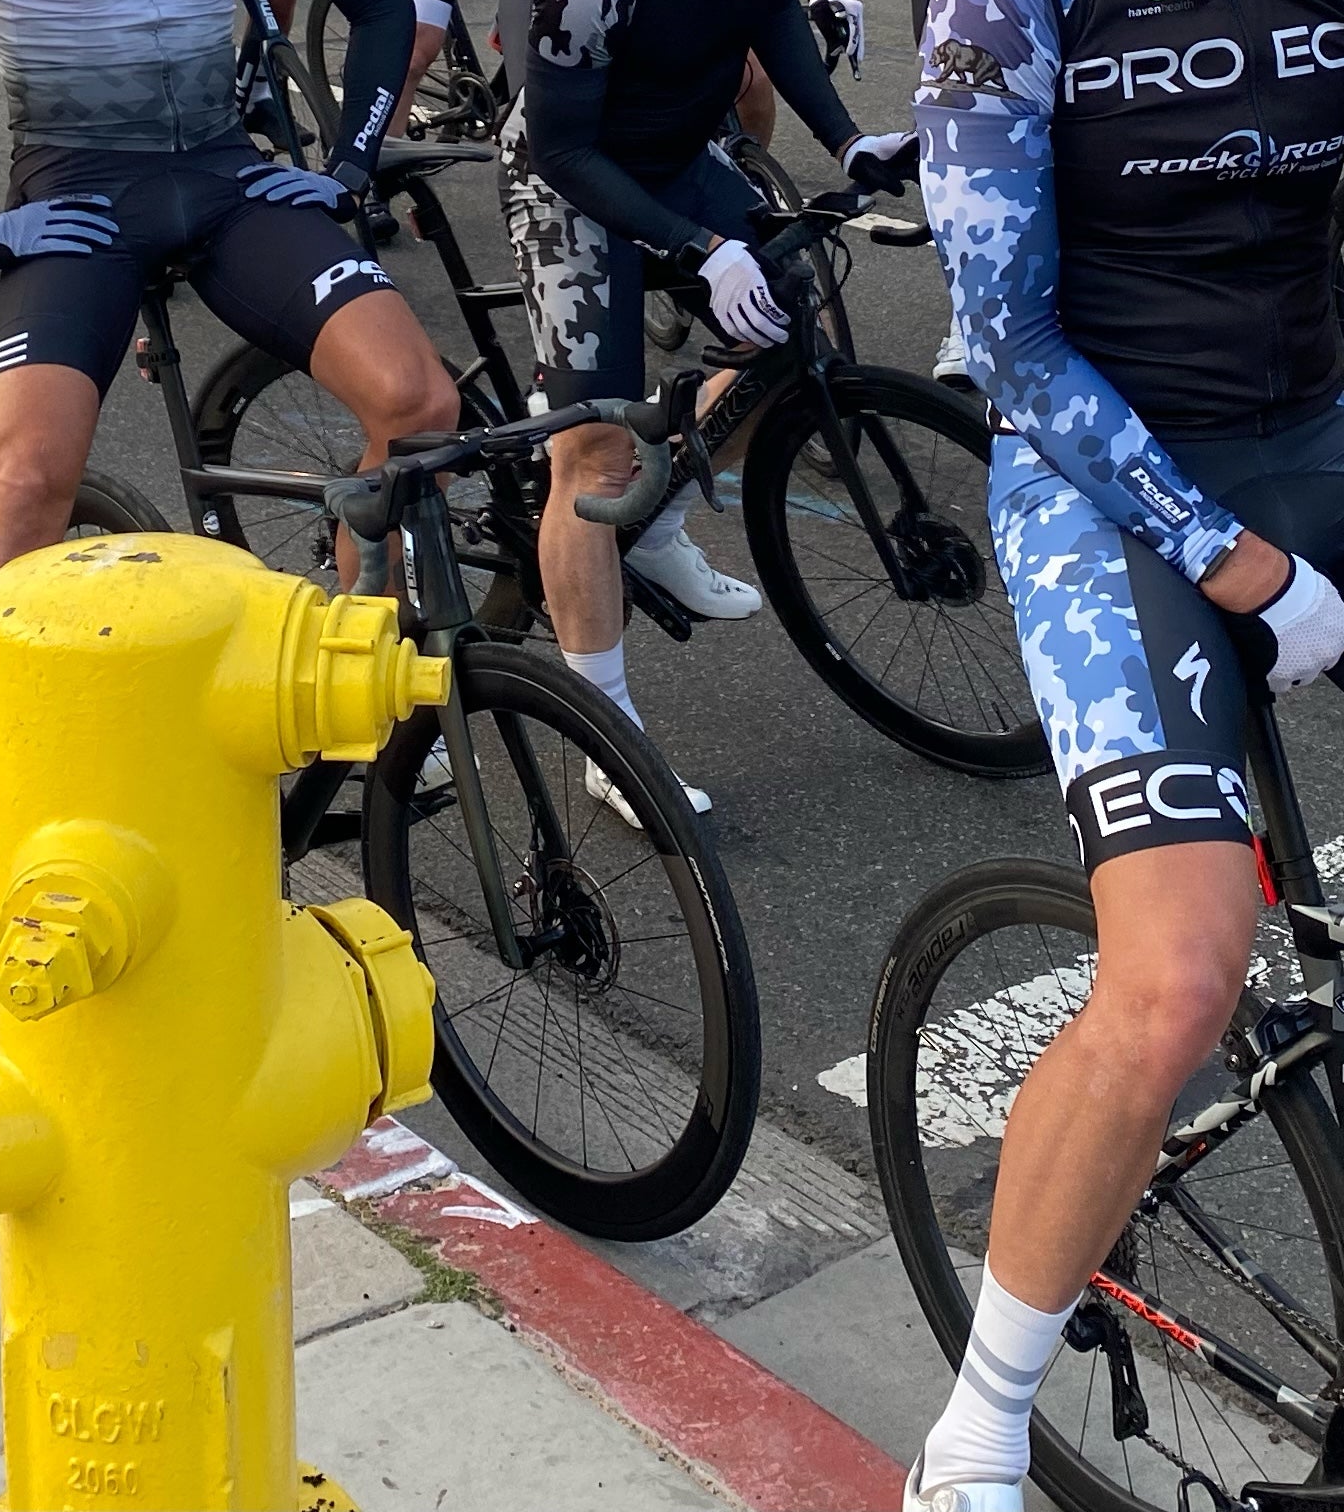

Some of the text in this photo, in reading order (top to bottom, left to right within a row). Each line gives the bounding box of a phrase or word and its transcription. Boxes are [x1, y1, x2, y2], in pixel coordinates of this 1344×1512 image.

[1065, 38, 1244, 103] PRO
[1139, 490, 1179, 524] INDUSTRIES
[870, 955, 898, 1054] CONTINENTAL
[49, 1392, 165, 1444] CLOW
[67, 1456, 139, 1496] 2060
